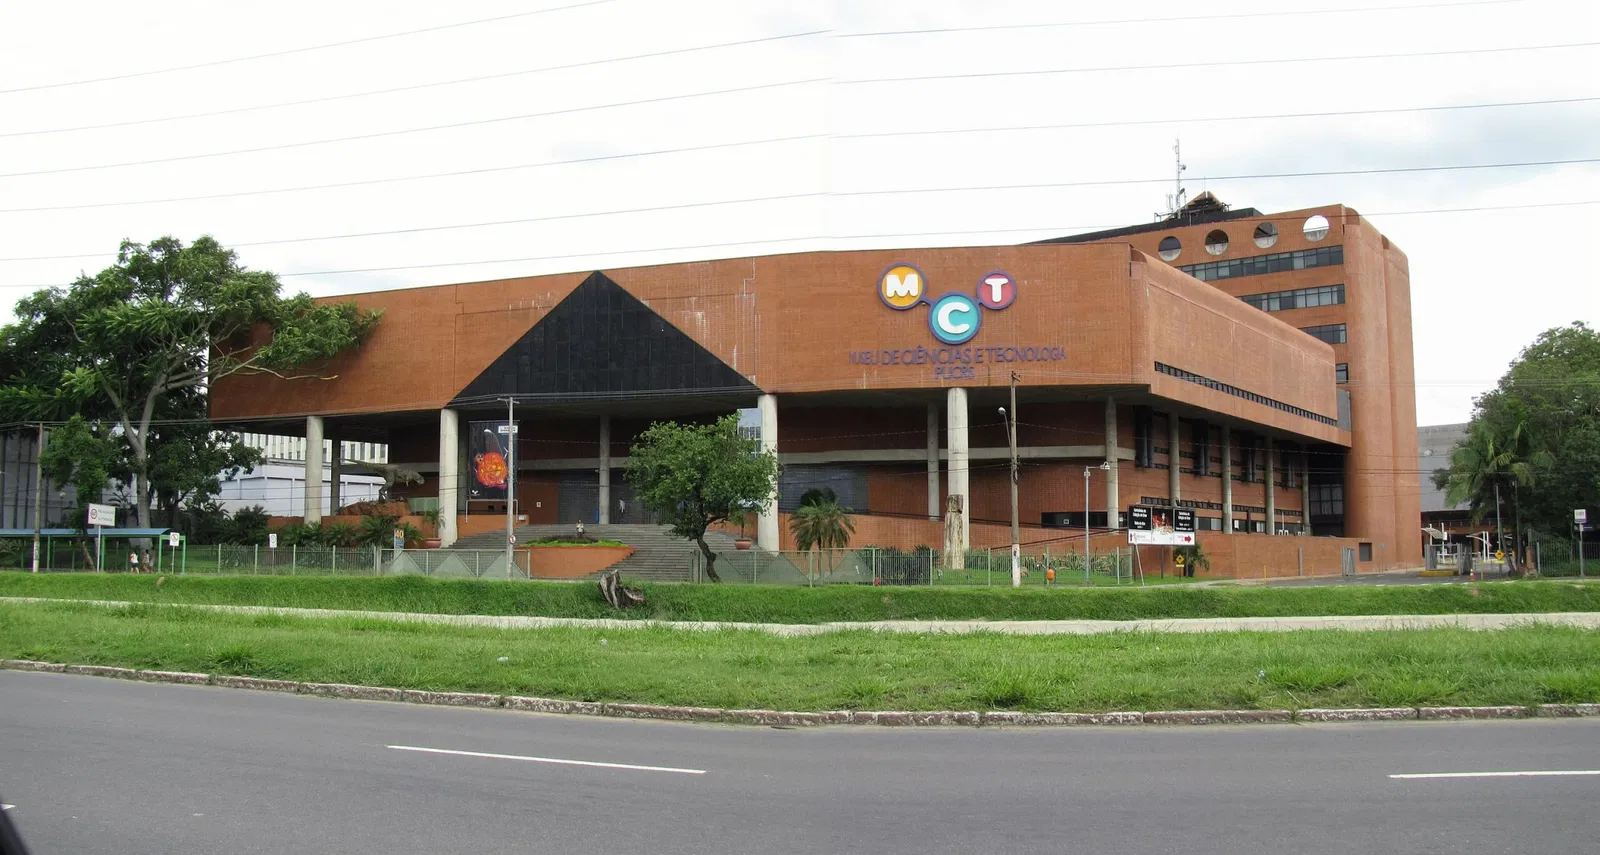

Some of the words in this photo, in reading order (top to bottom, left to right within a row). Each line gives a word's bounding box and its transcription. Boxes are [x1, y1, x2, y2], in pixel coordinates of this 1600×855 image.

[886, 274, 919, 298] M
[937, 301, 970, 334] C
[984, 278, 1009, 303] T
[849, 350, 880, 365] MUSEU
[881, 348, 900, 365] DE
[901, 344, 972, 365] CIÊNCIAS
[975, 348, 984, 364] E
[935, 365, 976, 380] PUCRS
